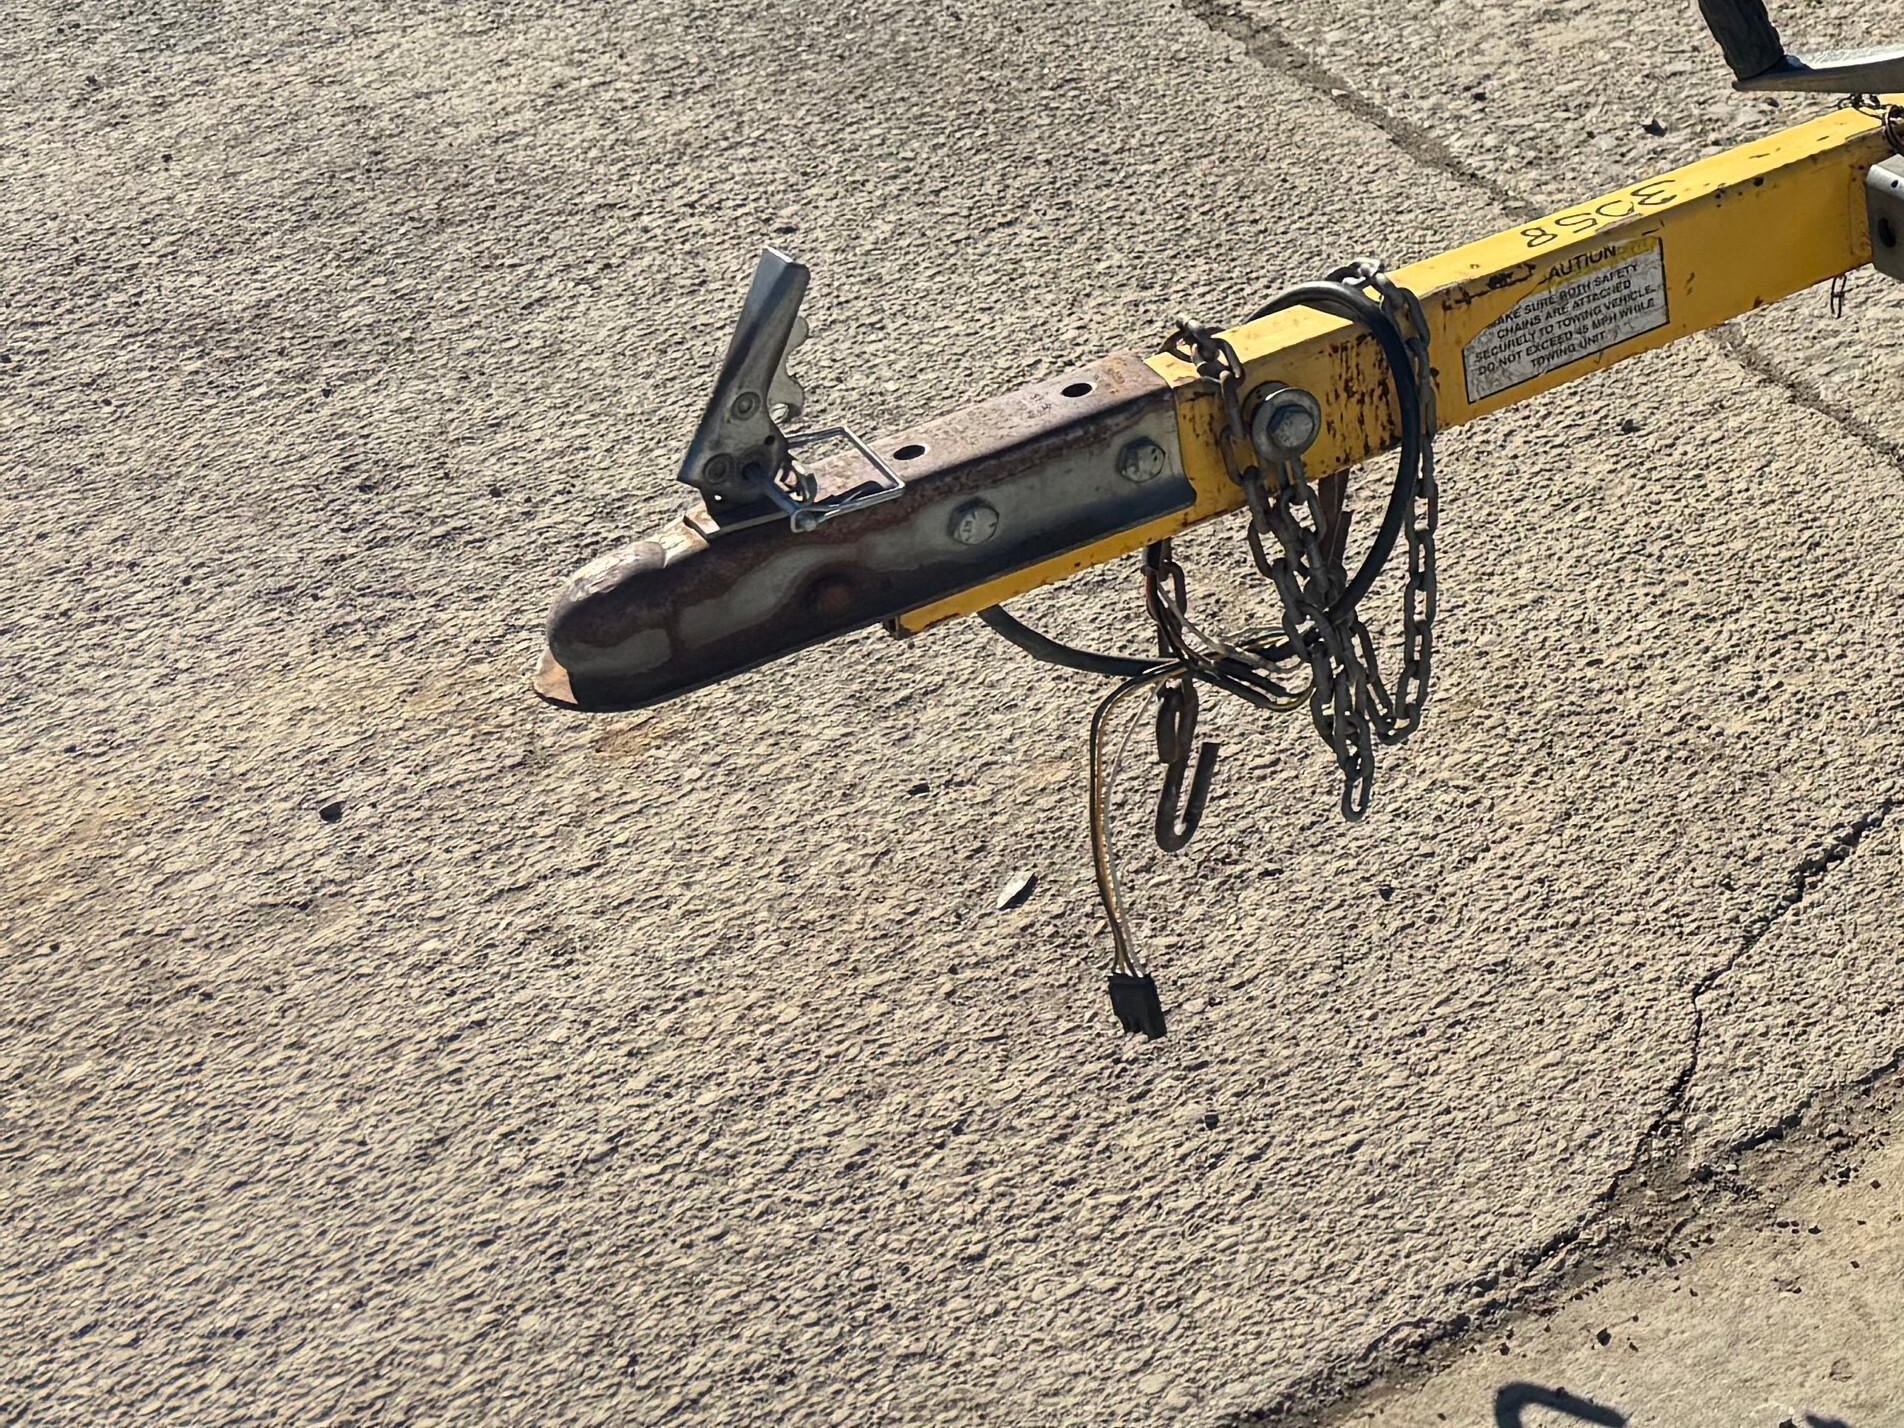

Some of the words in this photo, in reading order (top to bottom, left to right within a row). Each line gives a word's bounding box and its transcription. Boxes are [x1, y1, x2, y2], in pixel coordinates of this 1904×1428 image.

[1538, 245, 1617, 285] AUTION
[1523, 292, 1558, 316] SURE
[1593, 262, 1639, 287] SAFETY
[1474, 330, 1537, 363] SECURELY
[1539, 324, 1554, 337] TO
[1555, 305, 1603, 330] TOWING
[1496, 315, 1542, 340] CHAINS
[1544, 300, 1570, 322] ARE
[1499, 350, 1524, 367] NOT
[1525, 330, 1573, 357] EXCEED
[1591, 312, 1617, 331] MPH
[1531, 343, 1577, 368] TOWING
